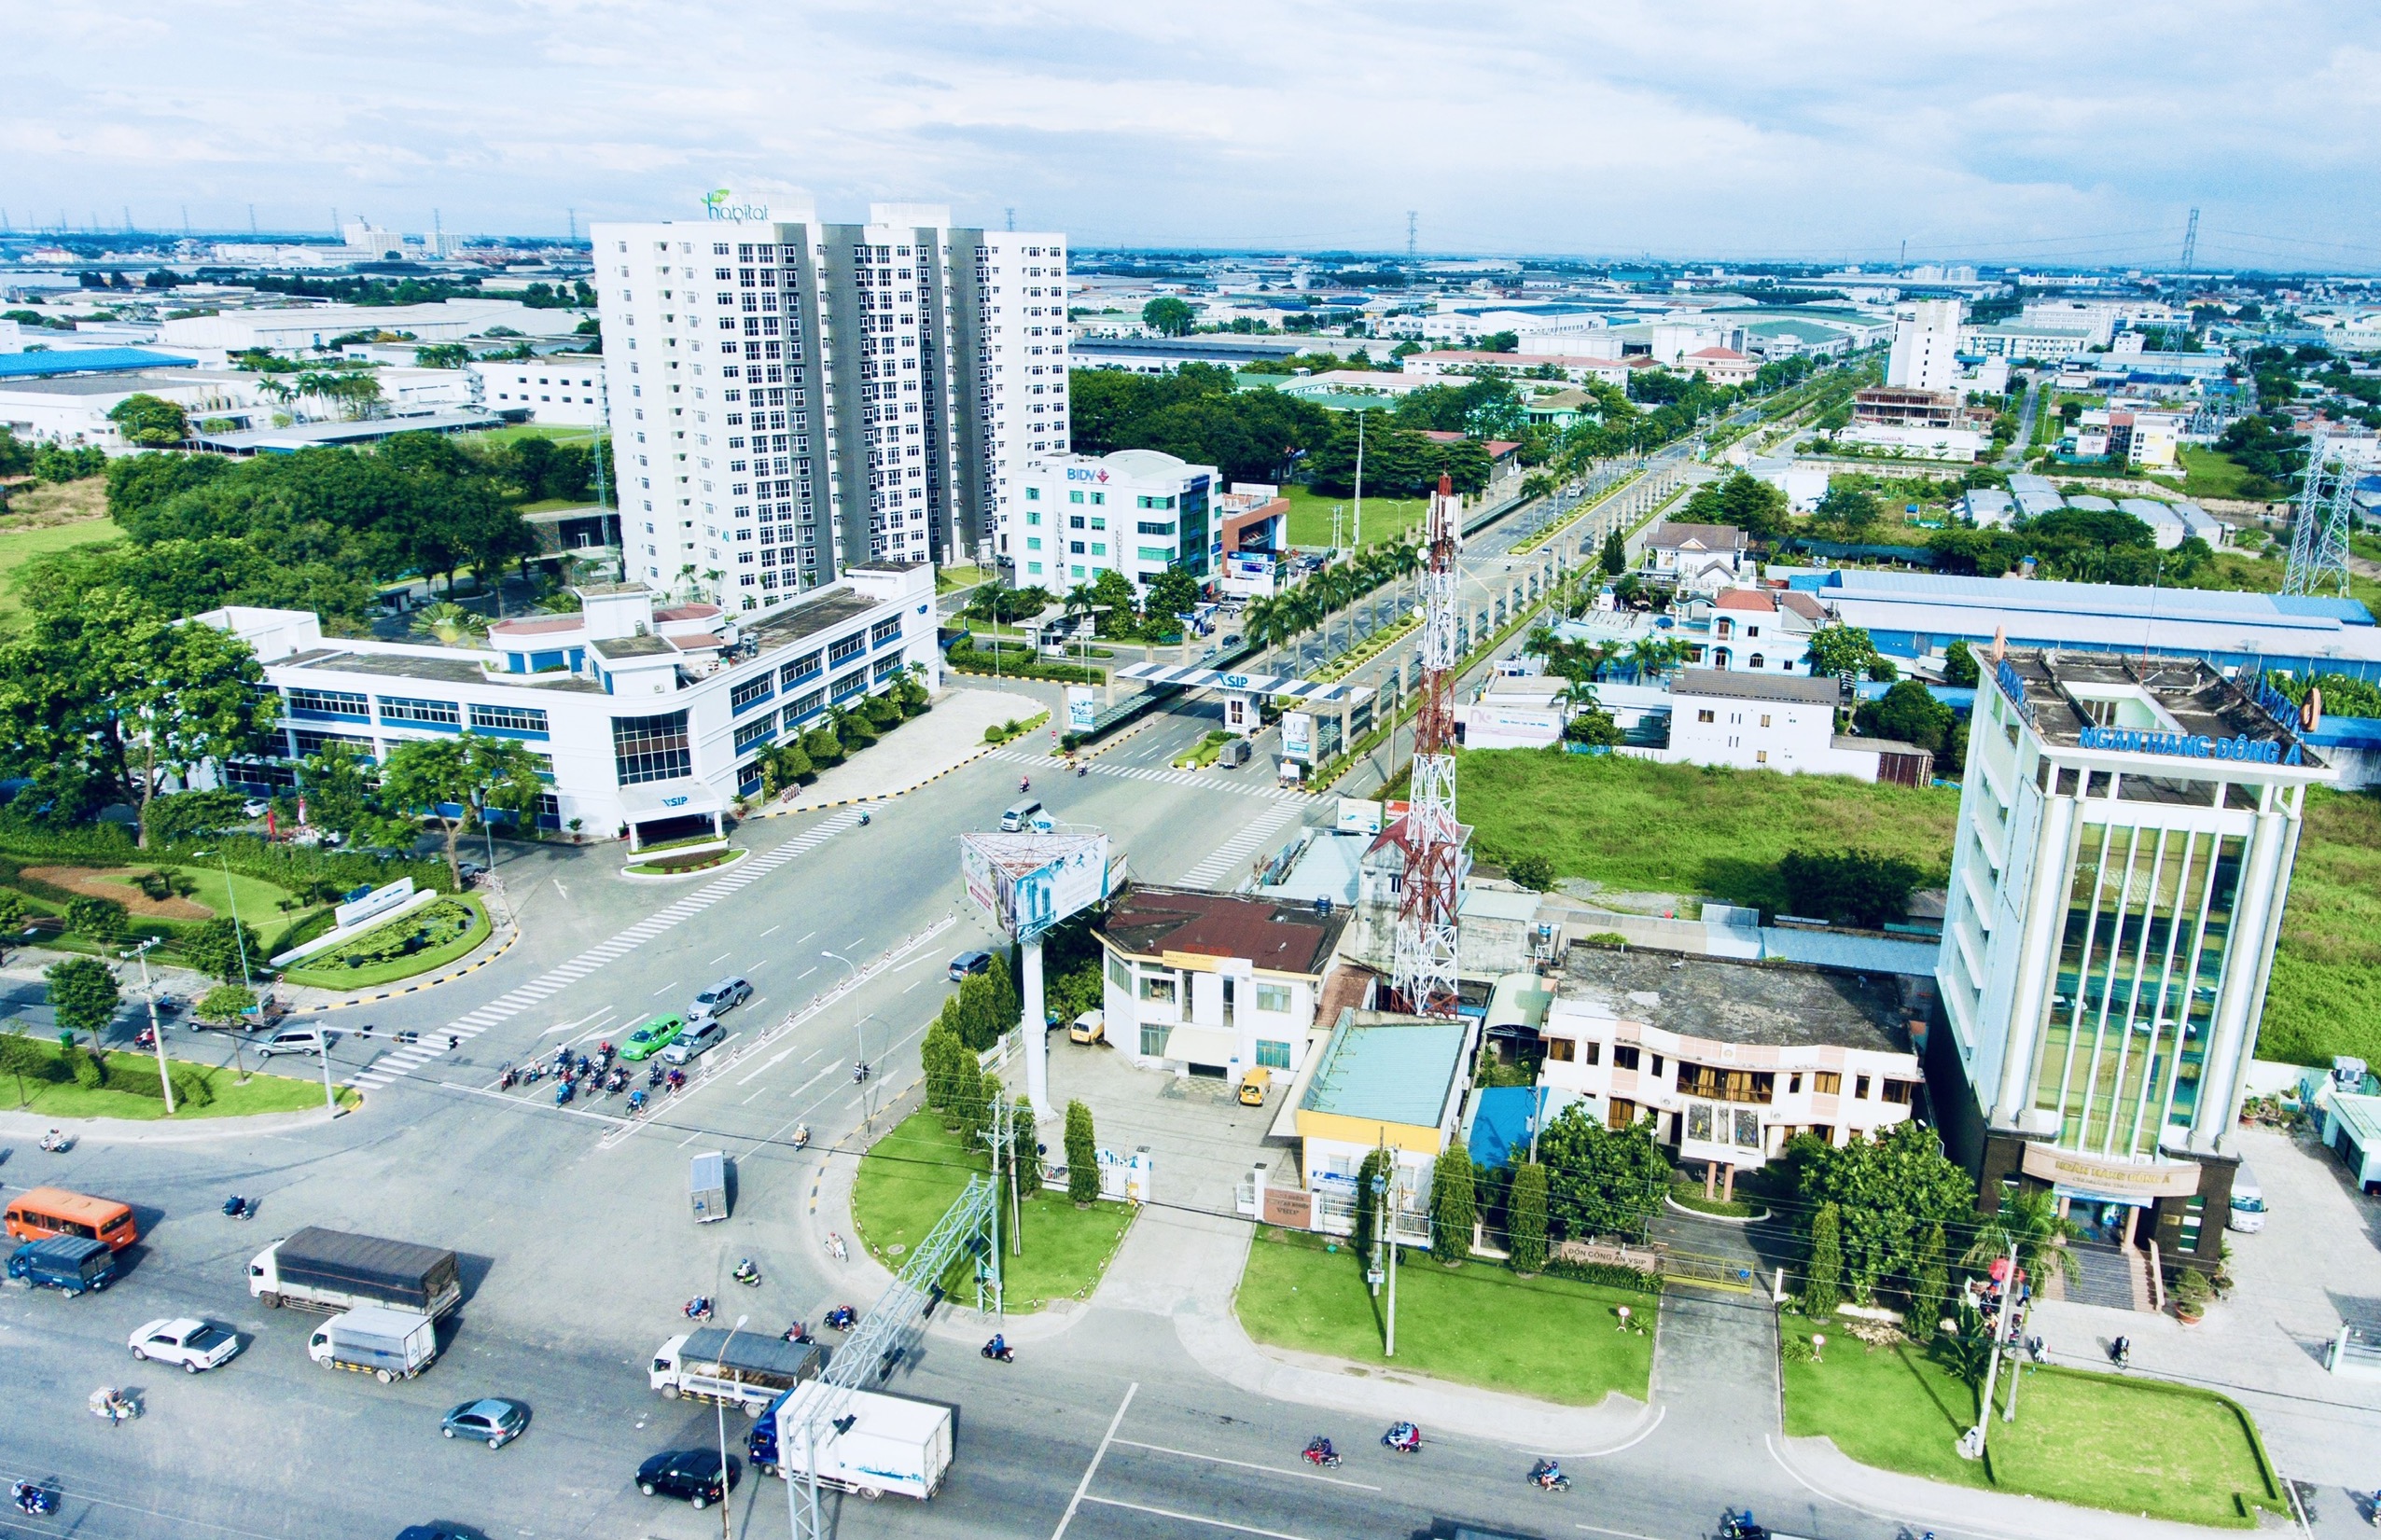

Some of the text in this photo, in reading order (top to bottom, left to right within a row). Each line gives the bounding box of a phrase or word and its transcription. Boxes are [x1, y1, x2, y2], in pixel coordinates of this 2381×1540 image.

[707, 192, 770, 220] habitat
[1066, 467, 1096, 481] BIDV
[2079, 725, 2142, 752] NGÂN
[2146, 728, 2210, 758] HÀNG
[2215, 733, 2281, 765] ĐÔNG
[661, 796, 688, 807] VSIP
[1614, 1255, 1626, 1263] AN
[1628, 1256, 1648, 1266] VSIP
